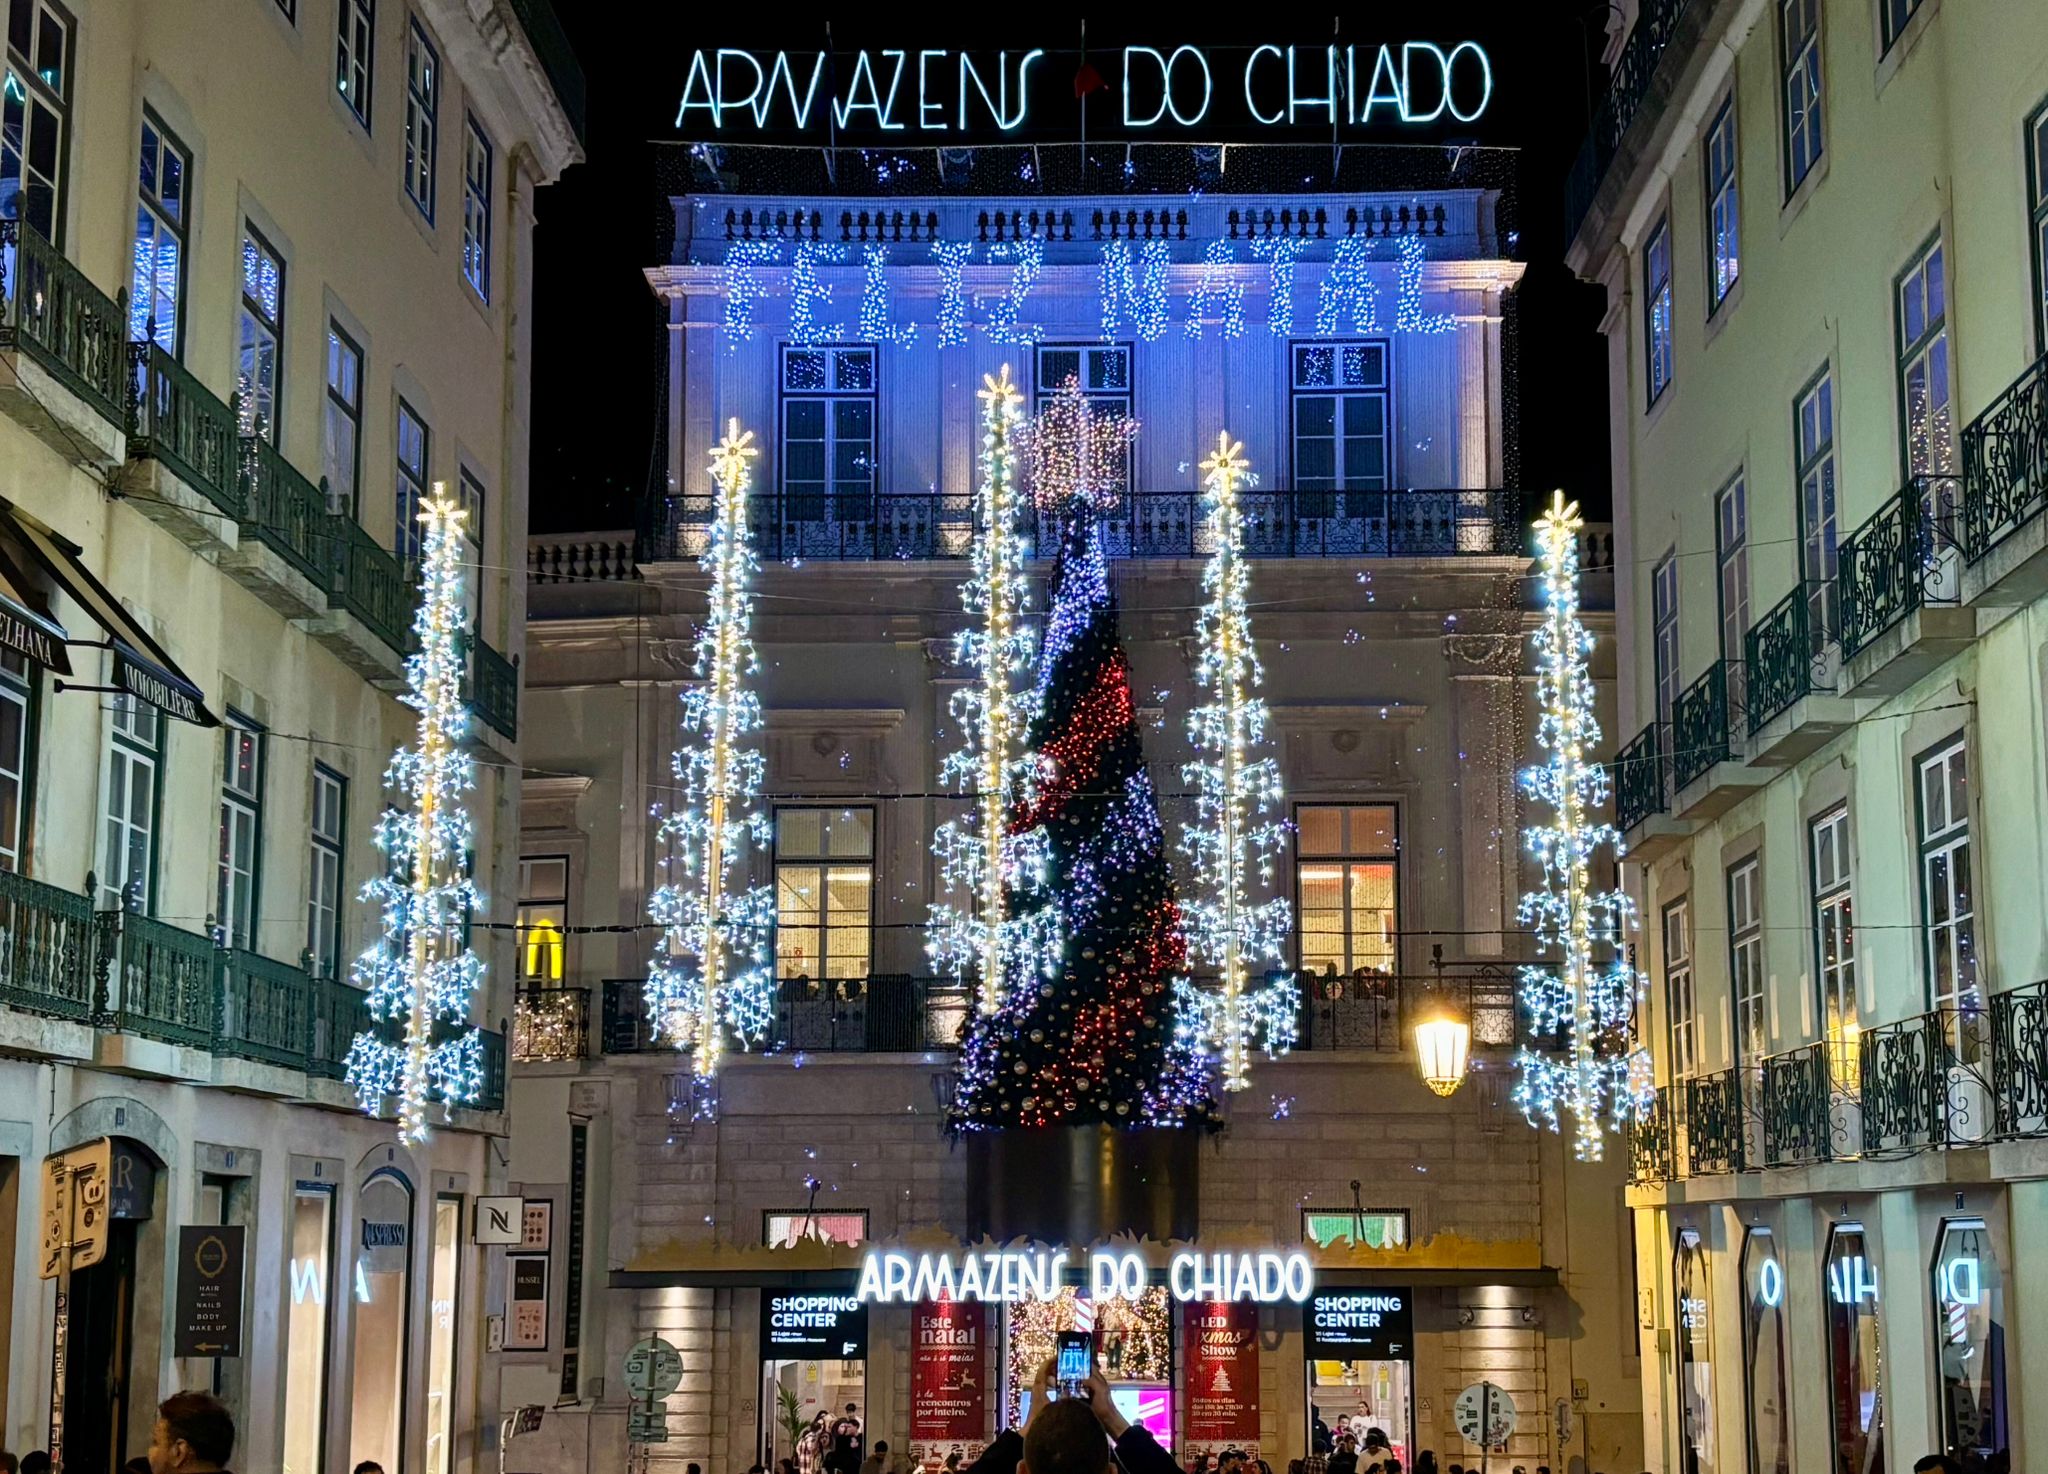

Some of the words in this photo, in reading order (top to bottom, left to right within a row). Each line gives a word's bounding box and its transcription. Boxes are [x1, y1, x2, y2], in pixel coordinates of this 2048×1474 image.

[674, 48, 1043, 130] ARMAZENS
[1123, 45, 1211, 126] DO
[1244, 41, 1492, 125] CHIADO
[722, 234, 1048, 350] FELIZ
[1099, 232, 1462, 346] NATAL
[123, 662, 202, 723] IMMOBILIÈRE
[361, 1218, 405, 1250] NESPRESSO
[857, 1253, 1067, 1302] ARMAZENS
[1091, 1253, 1146, 1302] DO
[1170, 1253, 1313, 1302] CHIADO
[771, 1296, 858, 1312] SHOPPING
[1314, 1296, 1402, 1312] SHOPPING
[771, 1313, 837, 1328] CENTER
[920, 1315, 952, 1329] Este
[1200, 1316, 1227, 1328] LED
[1314, 1312, 1381, 1328] CENTER
[920, 1326, 976, 1344] natal
[1200, 1331, 1243, 1344] xmas
[948, 1352, 974, 1362] meias
[1201, 1345, 1237, 1356] Show
[916, 1399, 972, 1407] reencontros
[916, 1409, 933, 1418] por
[934, 1408, 968, 1416] inteiro.
